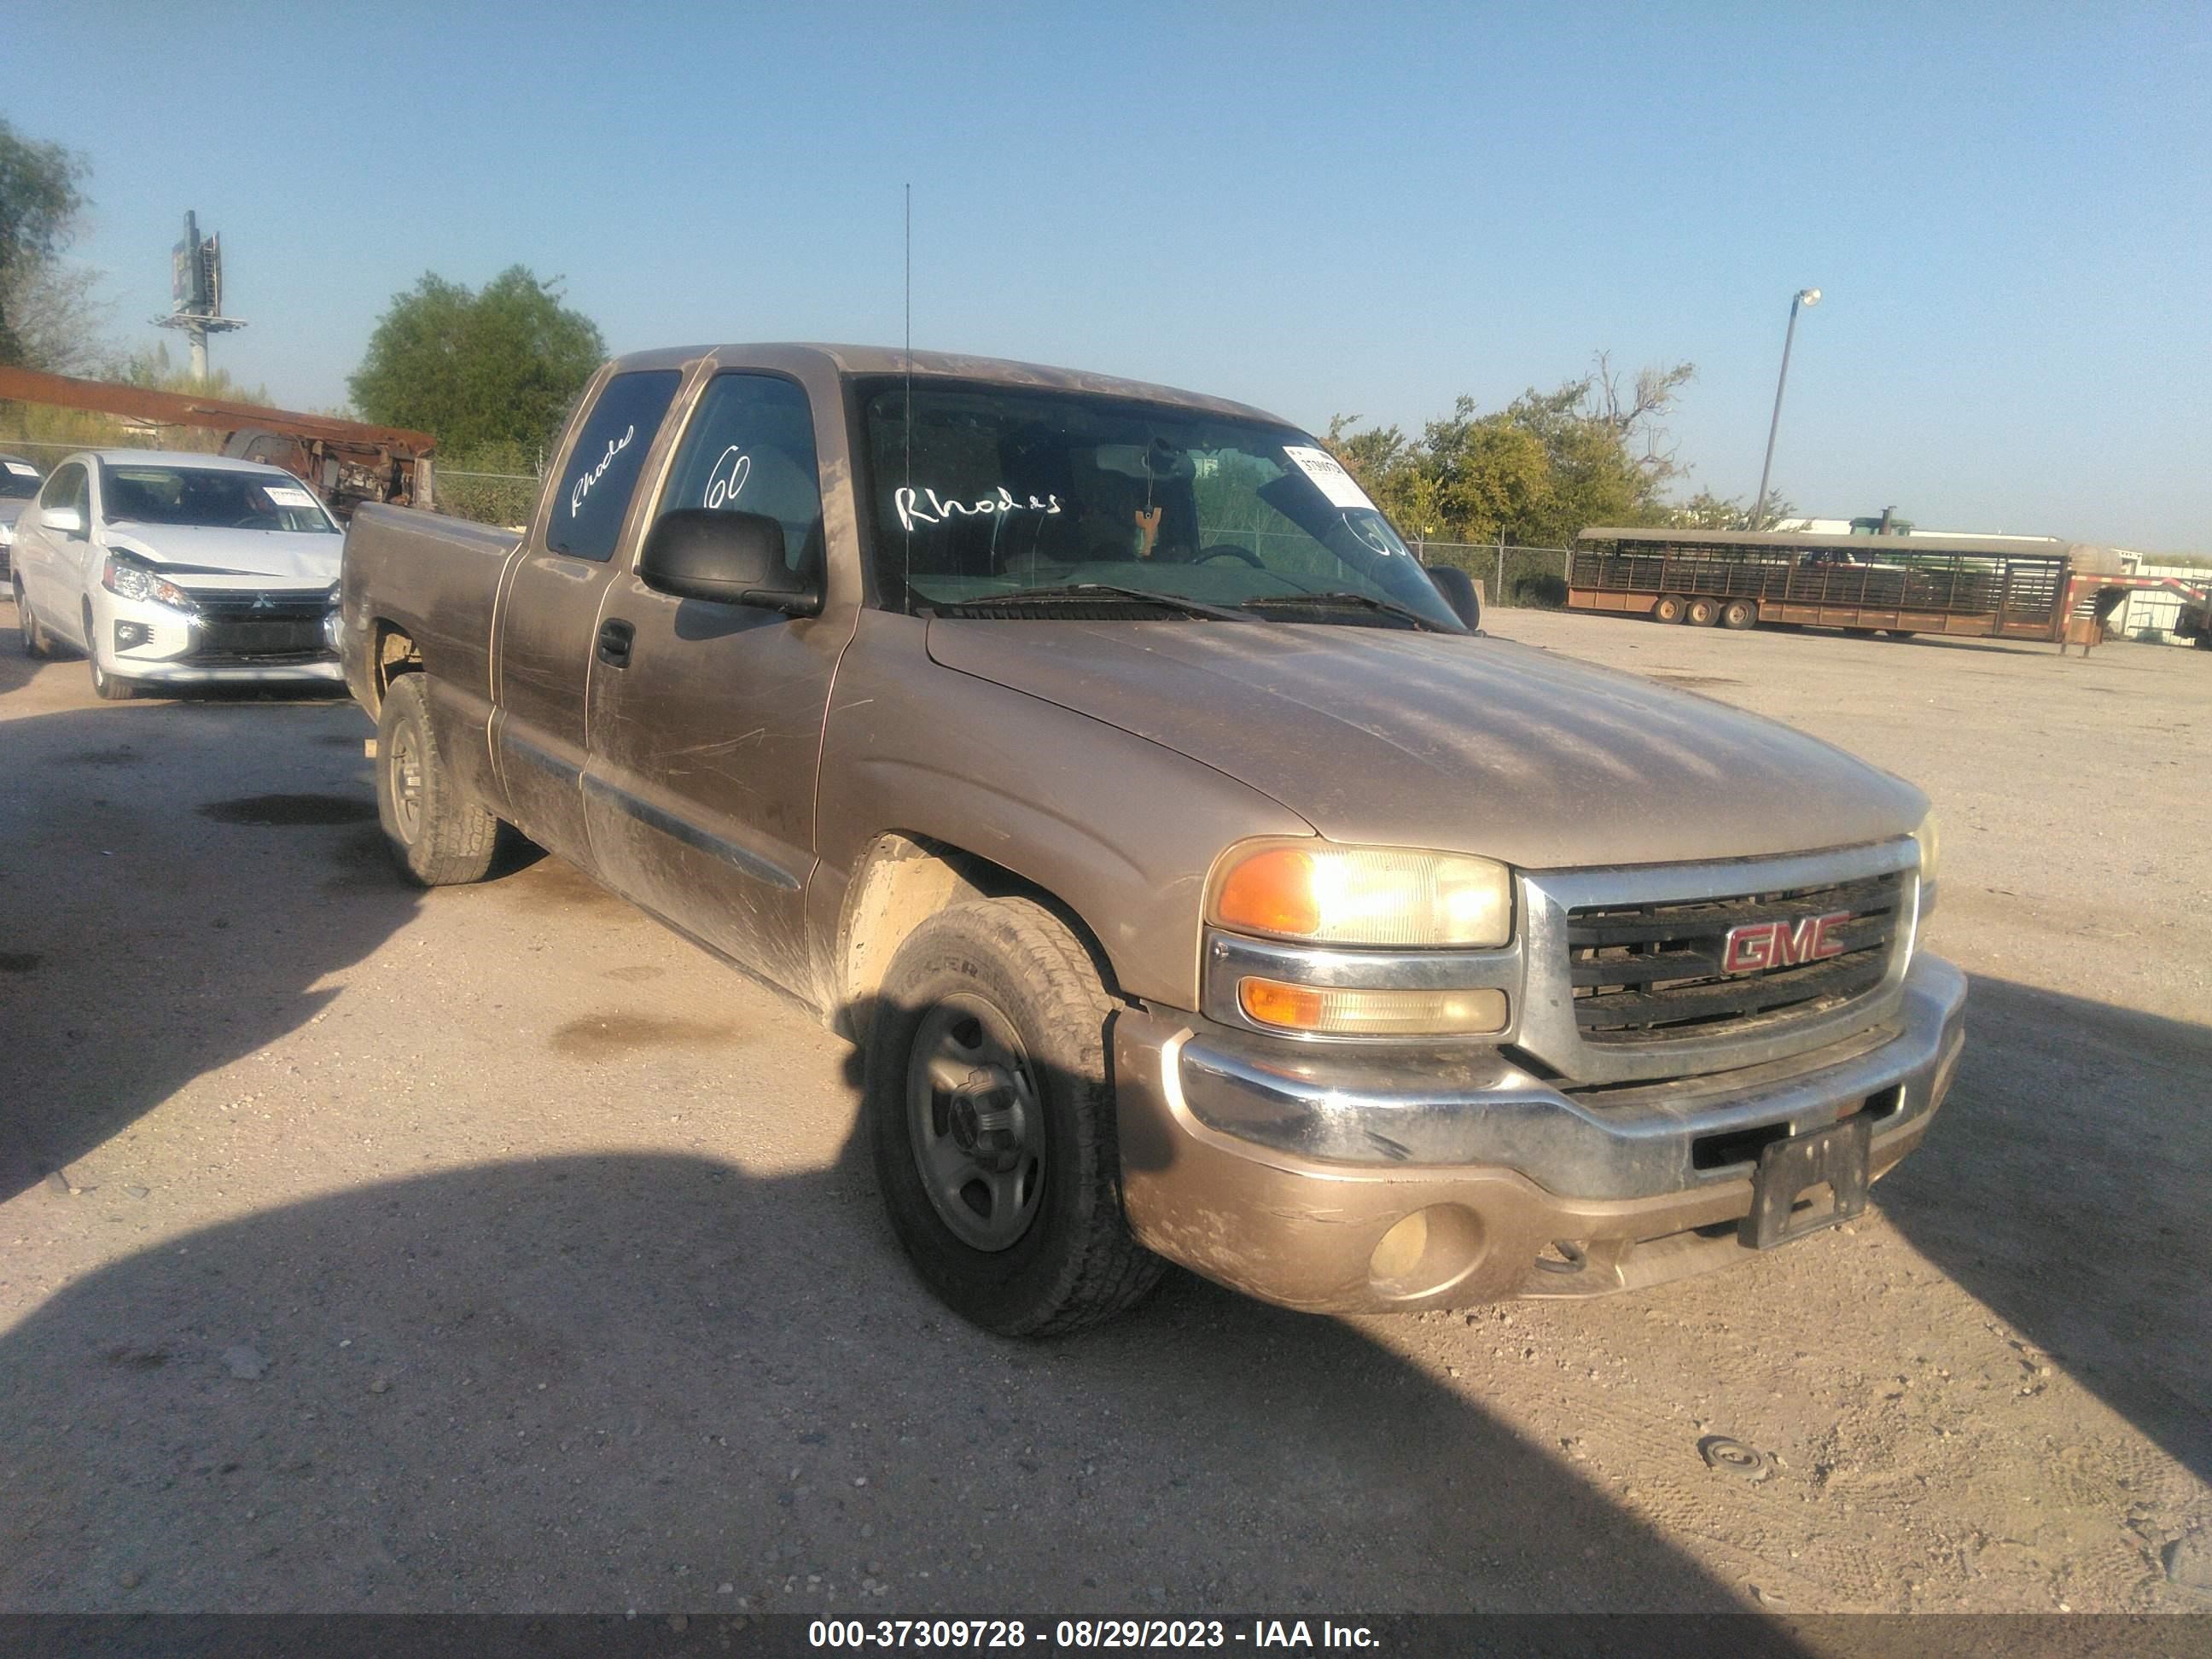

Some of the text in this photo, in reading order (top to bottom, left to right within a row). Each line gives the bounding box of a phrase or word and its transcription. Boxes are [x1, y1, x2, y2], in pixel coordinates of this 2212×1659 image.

[703, 445, 751, 509] 60
[894, 486, 1062, 531] Rhodes
[1722, 911, 1850, 973] GMC
